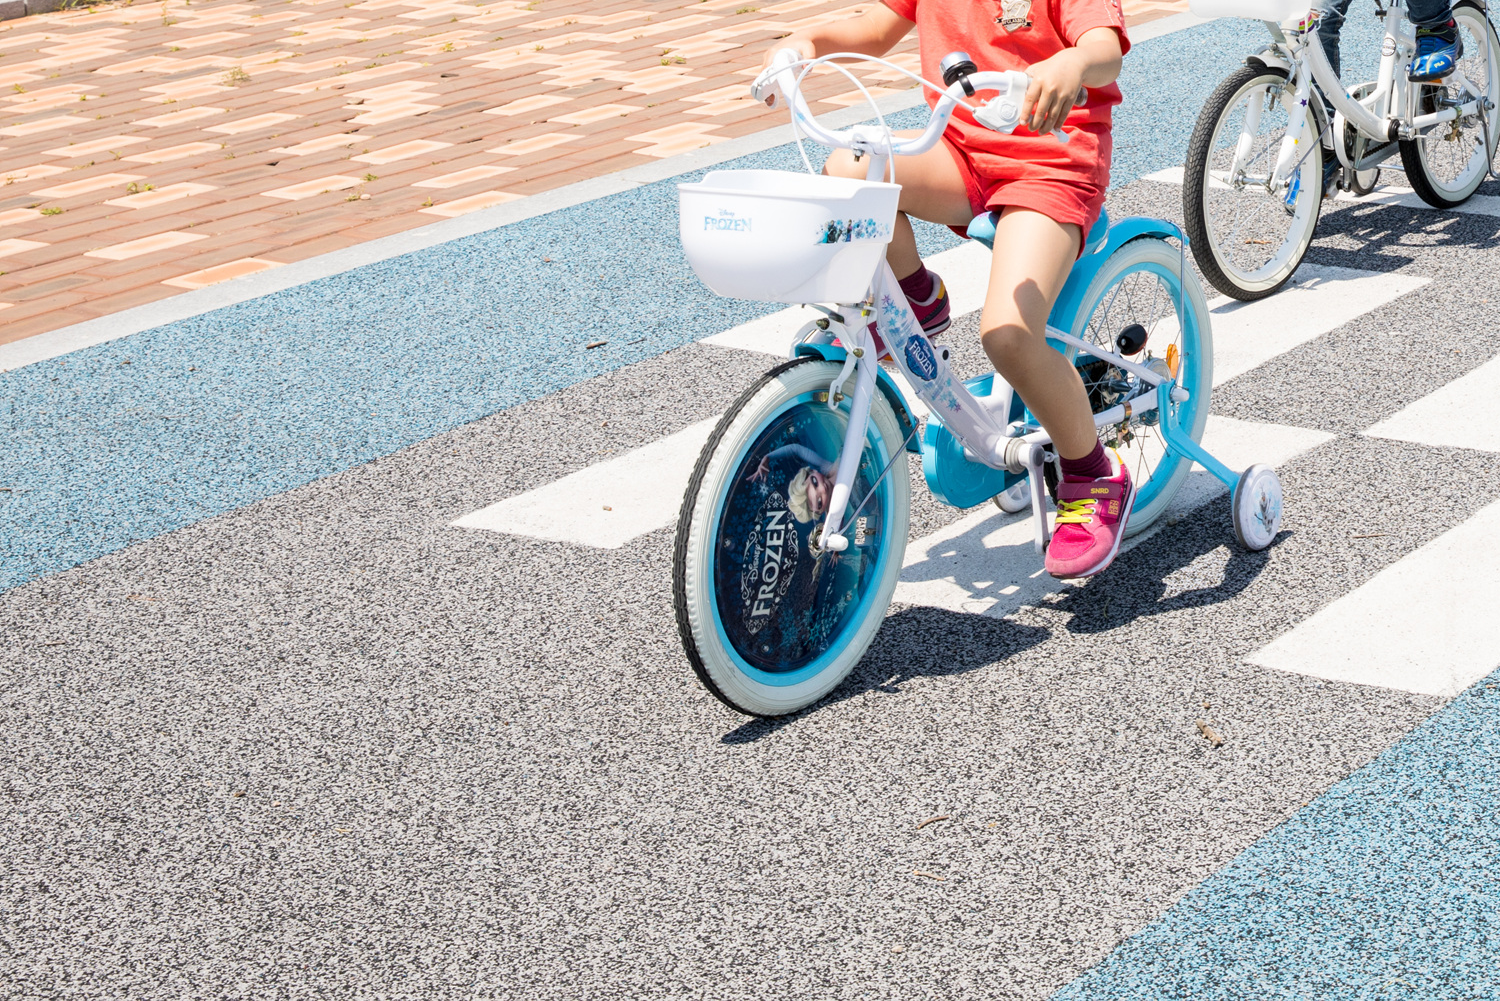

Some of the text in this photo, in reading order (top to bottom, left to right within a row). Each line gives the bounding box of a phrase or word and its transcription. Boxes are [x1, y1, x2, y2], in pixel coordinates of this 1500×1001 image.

[703, 215, 753, 232] FROZEN
[908, 340, 935, 378] FROZEN
[750, 509, 788, 618] FROZEN
